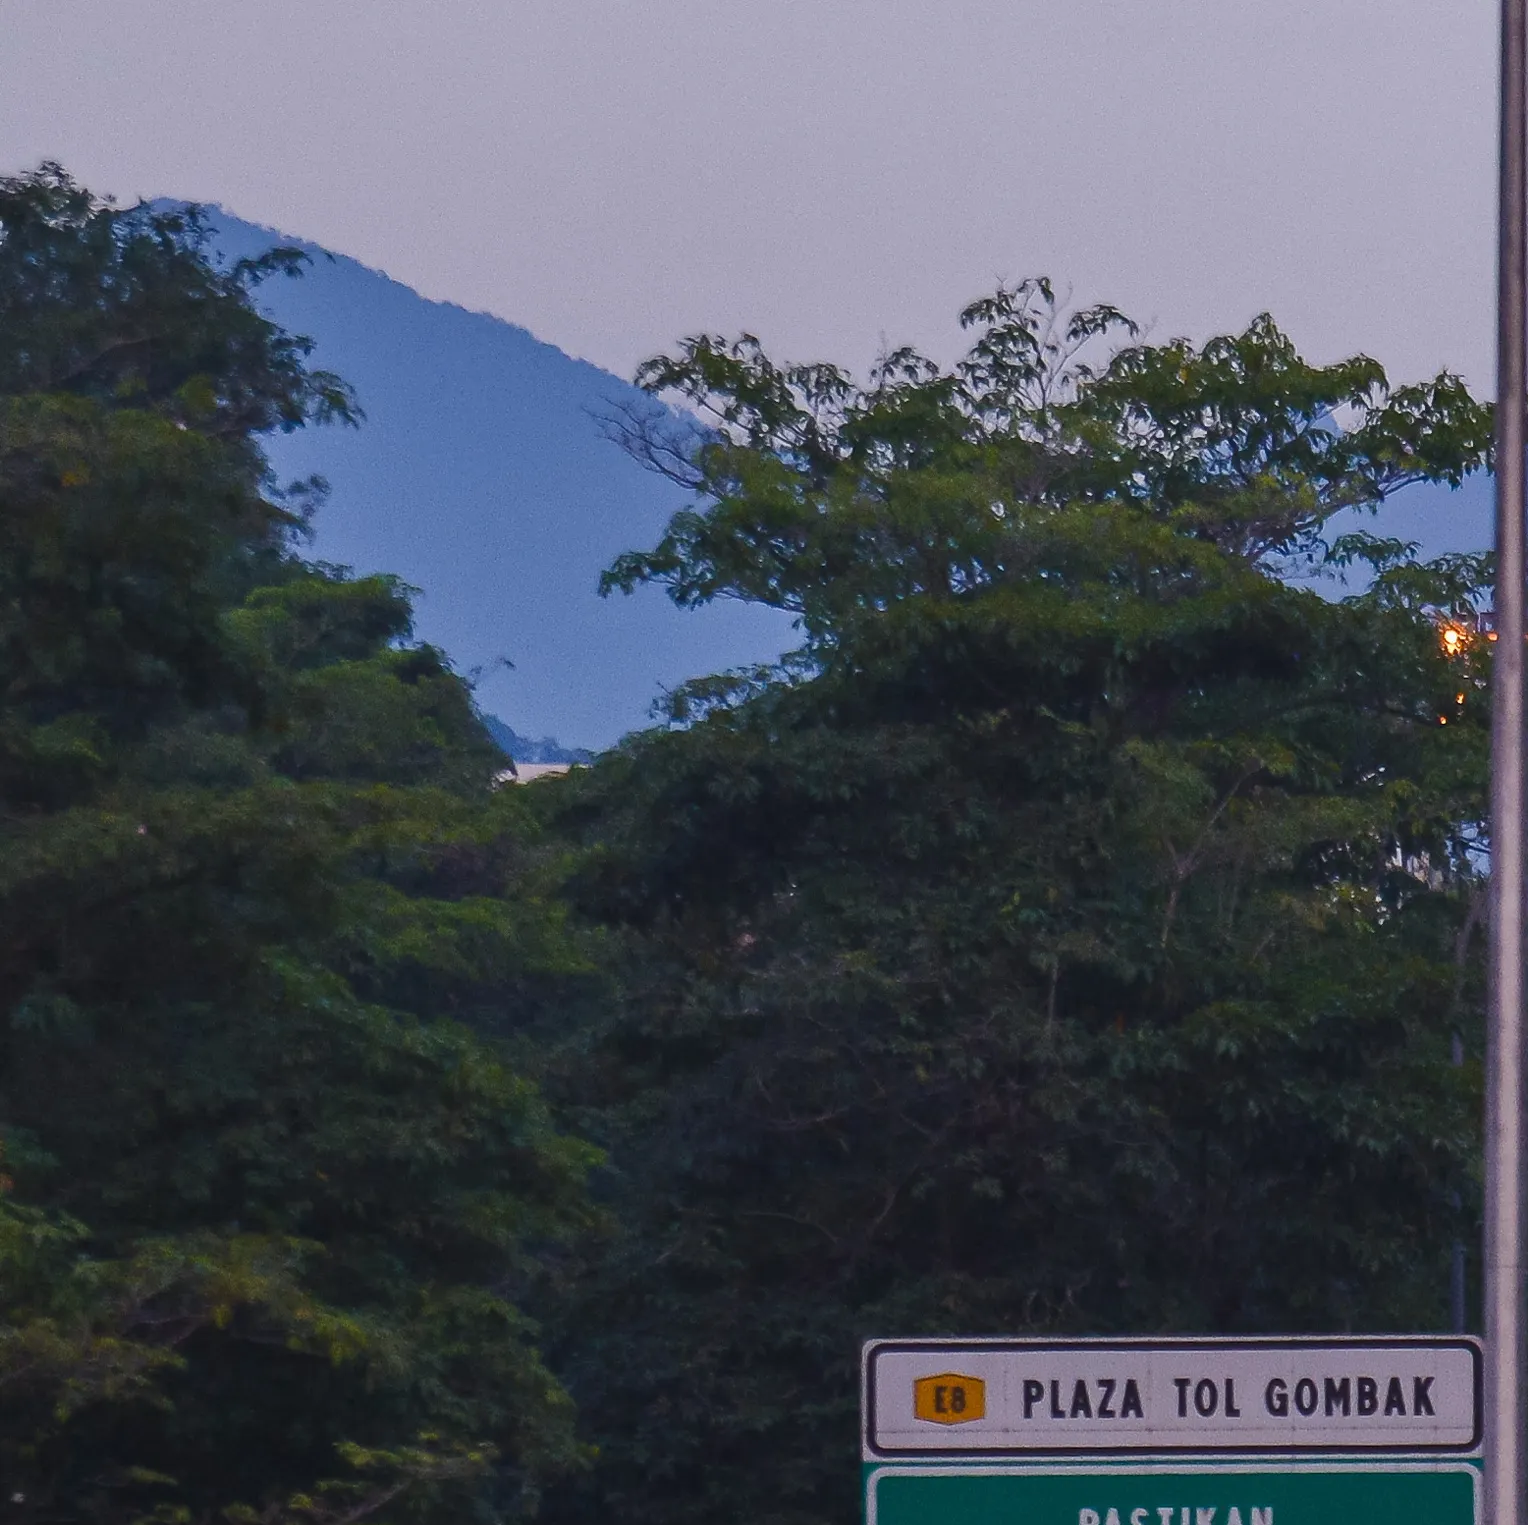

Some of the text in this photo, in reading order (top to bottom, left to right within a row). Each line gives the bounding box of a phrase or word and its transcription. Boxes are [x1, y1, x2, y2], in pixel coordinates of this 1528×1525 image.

[933, 1375, 1437, 1419] E8 PLAZA TOL GOMBAK
